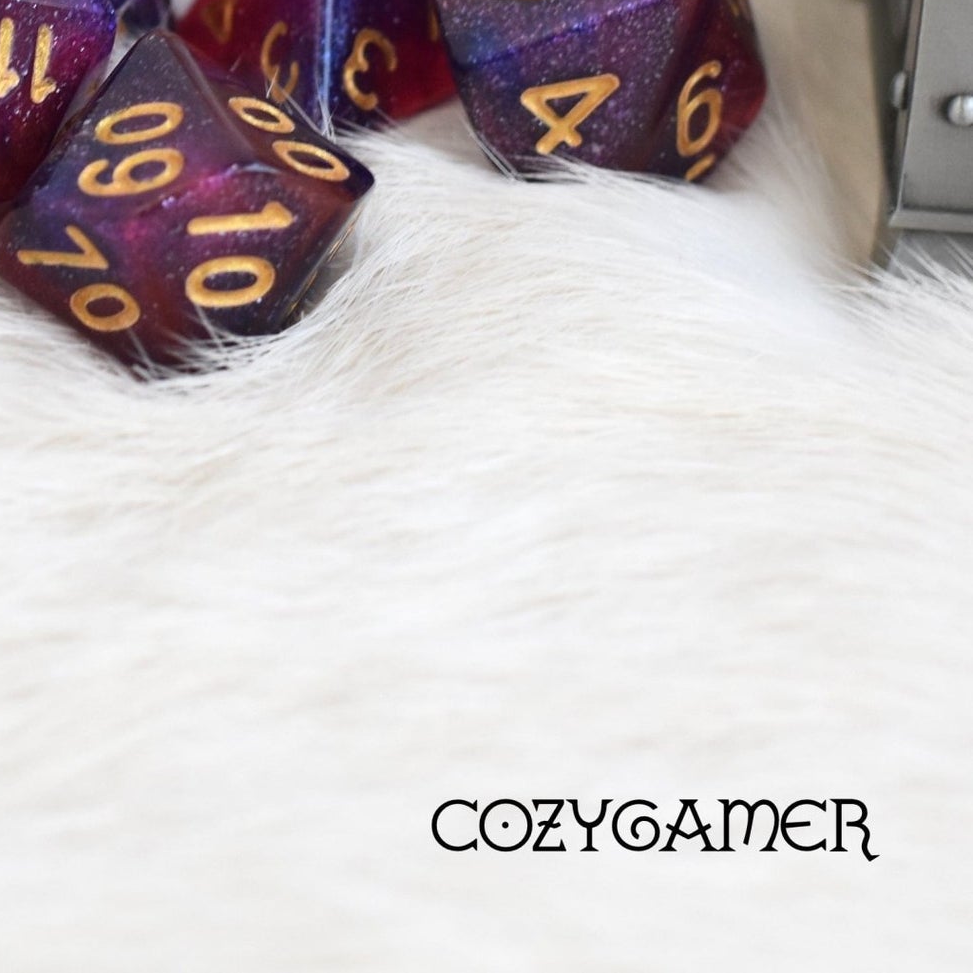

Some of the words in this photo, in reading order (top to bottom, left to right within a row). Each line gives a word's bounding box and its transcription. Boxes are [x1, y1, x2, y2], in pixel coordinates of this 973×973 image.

[342, 27, 397, 111] 3
[519, 73, 621, 155] 4
[17, 225, 141, 332] 70
[185, 201, 295, 309] 10
